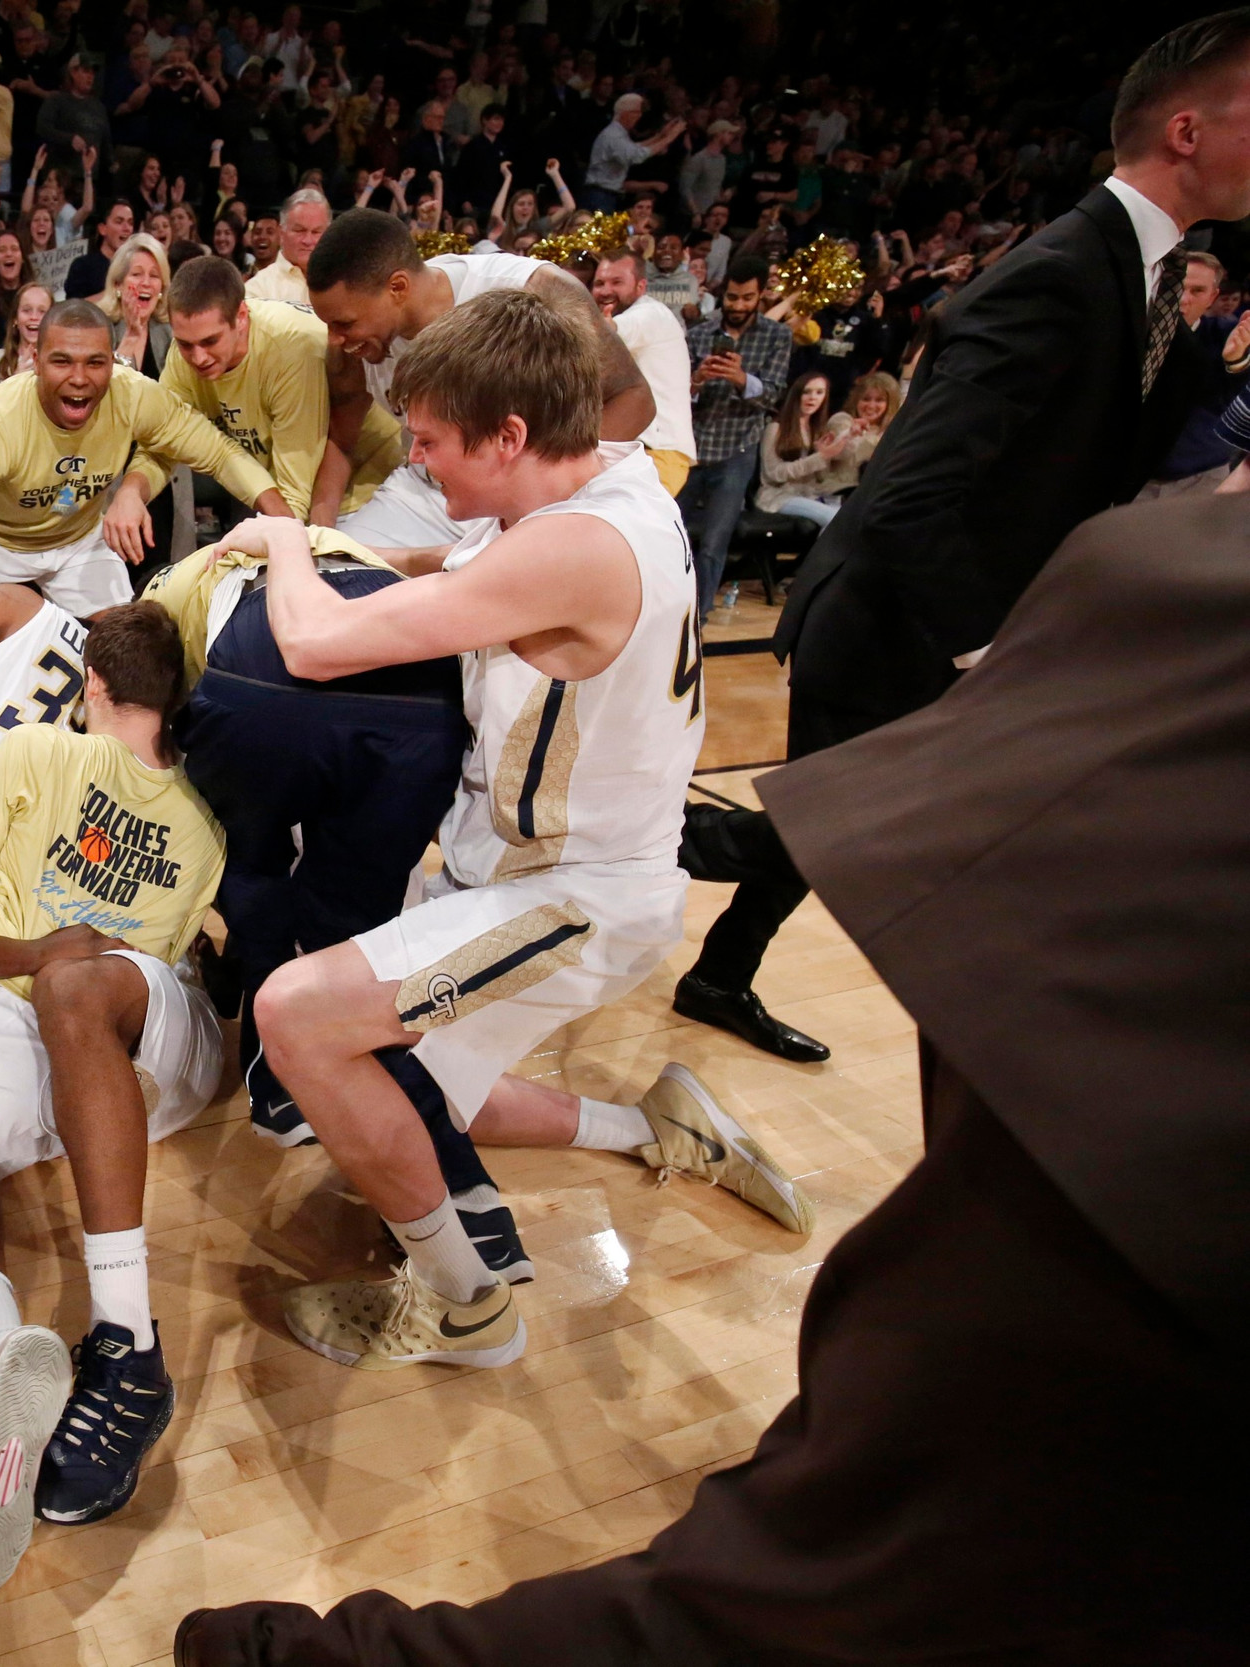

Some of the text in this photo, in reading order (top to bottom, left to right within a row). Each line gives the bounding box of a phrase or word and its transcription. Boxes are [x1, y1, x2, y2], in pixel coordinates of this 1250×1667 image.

[92, 473, 113, 484] WE
[80, 782, 171, 857] COACHES
[93, 1260, 139, 1271] RUSSELL
